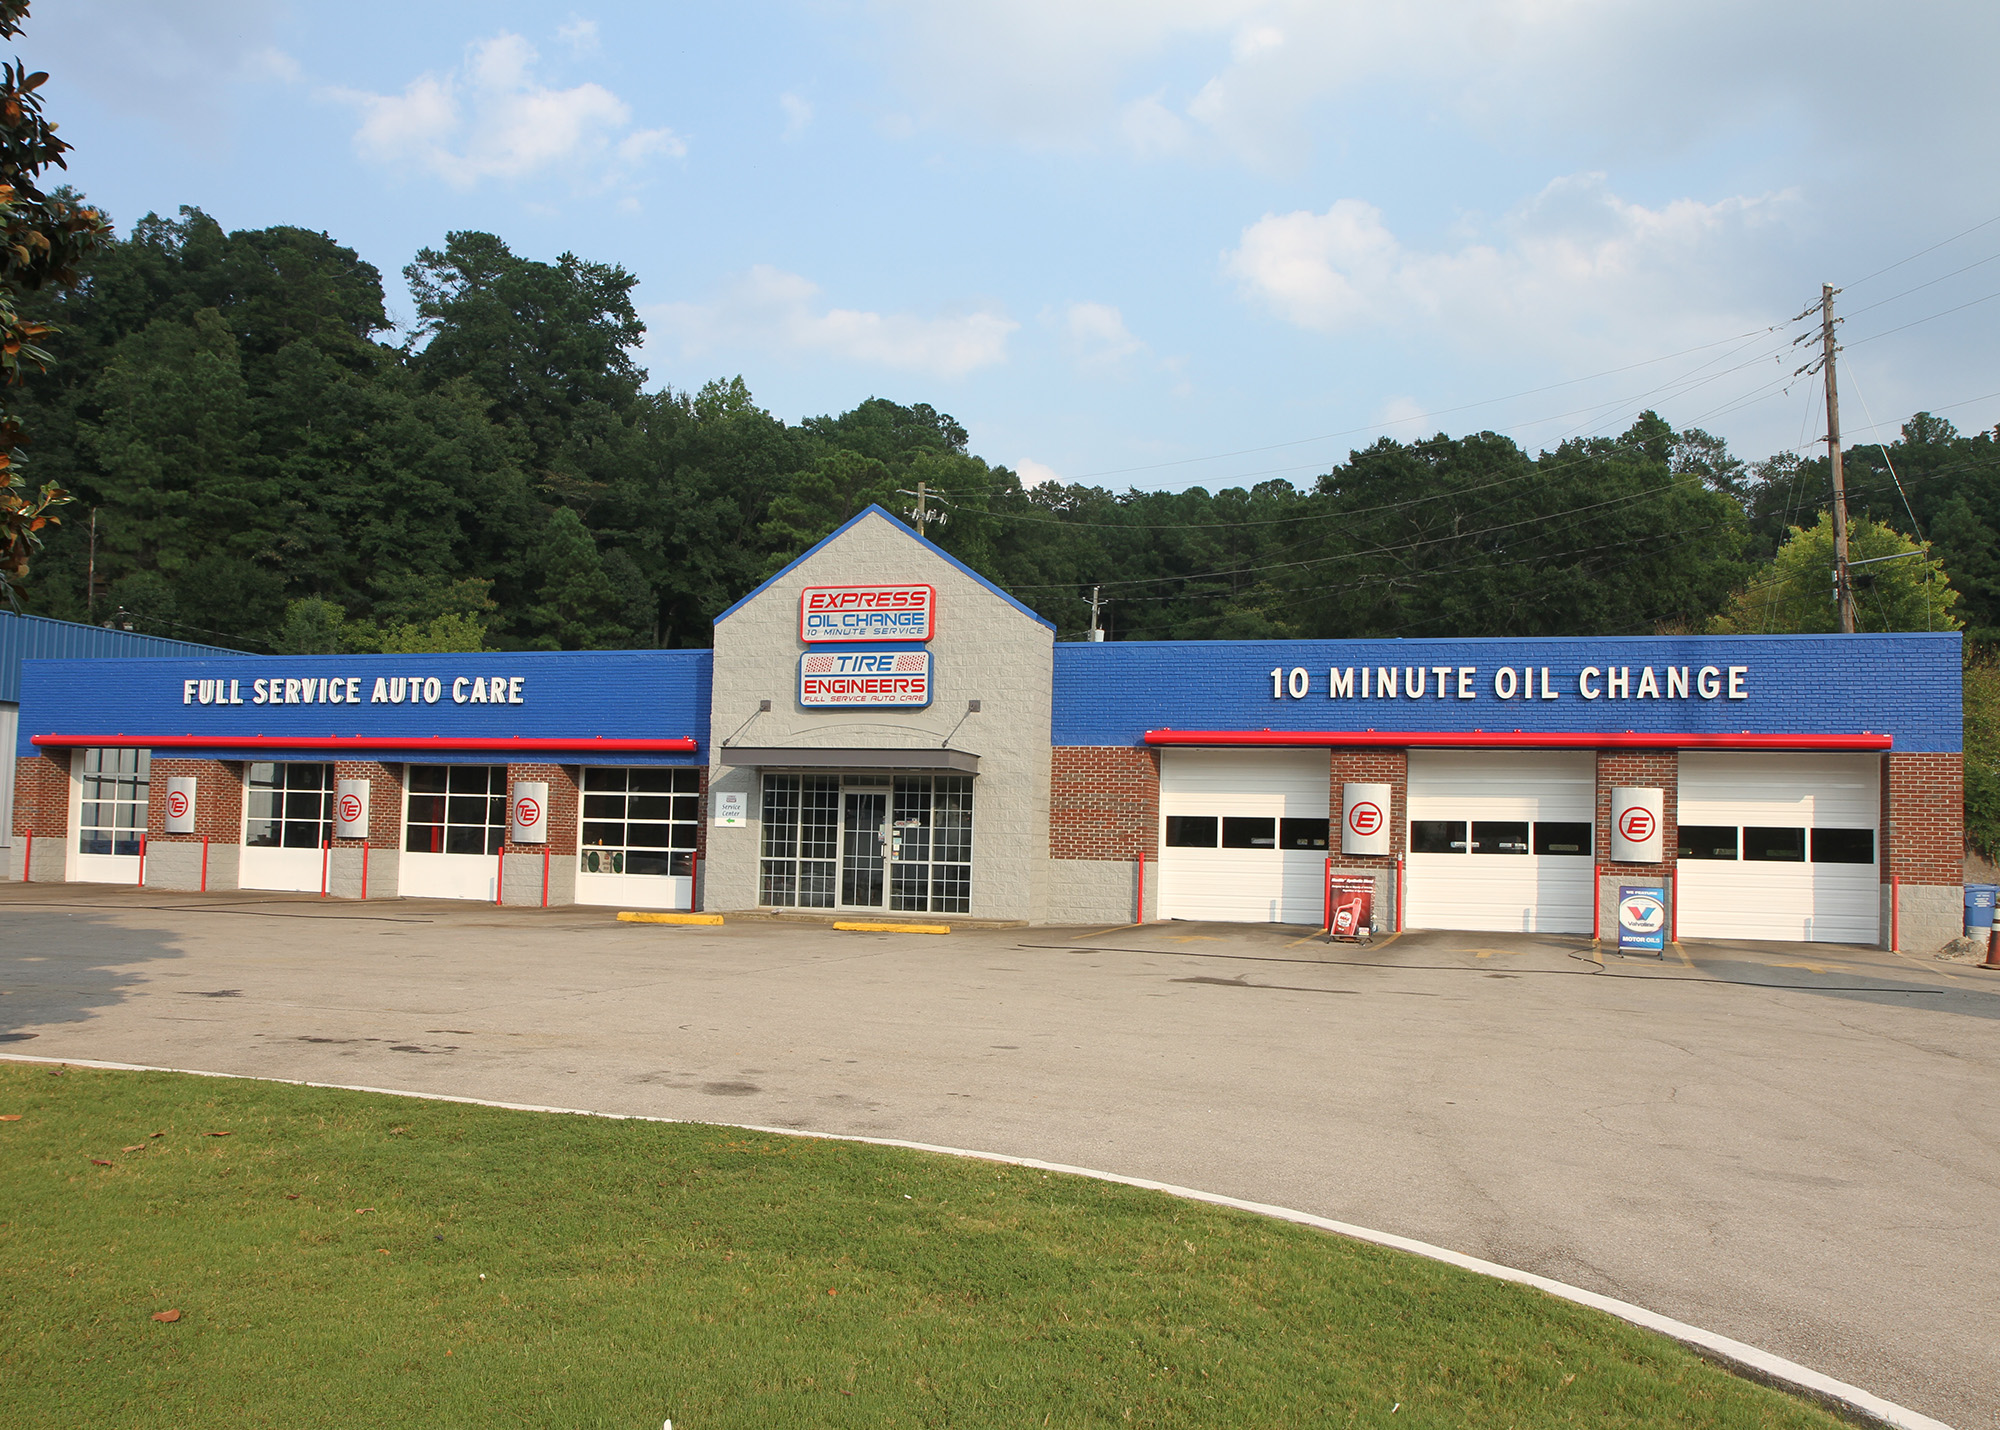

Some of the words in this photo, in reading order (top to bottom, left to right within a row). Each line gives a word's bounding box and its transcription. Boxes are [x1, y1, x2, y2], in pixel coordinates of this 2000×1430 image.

[808, 591, 927, 609] EXPRESS
[807, 614, 838, 628] OIL
[842, 612, 925, 627] CHANGE
[823, 628, 867, 636] MINUTE
[873, 627, 925, 635] SERVICE
[836, 655, 895, 672] TIRE
[804, 678, 926, 694] ENGINEERS
[1270, 667, 1309, 699] 10
[1329, 666, 1477, 699] MINUTE
[1494, 666, 1559, 699] OIL
[1579, 665, 1748, 699] CHANGE
[183, 679, 244, 705] FULL
[252, 677, 362, 704] SERVICE
[370, 677, 442, 704] AUTO
[452, 676, 525, 704] CARE
[899, 694, 925, 702] CARE
